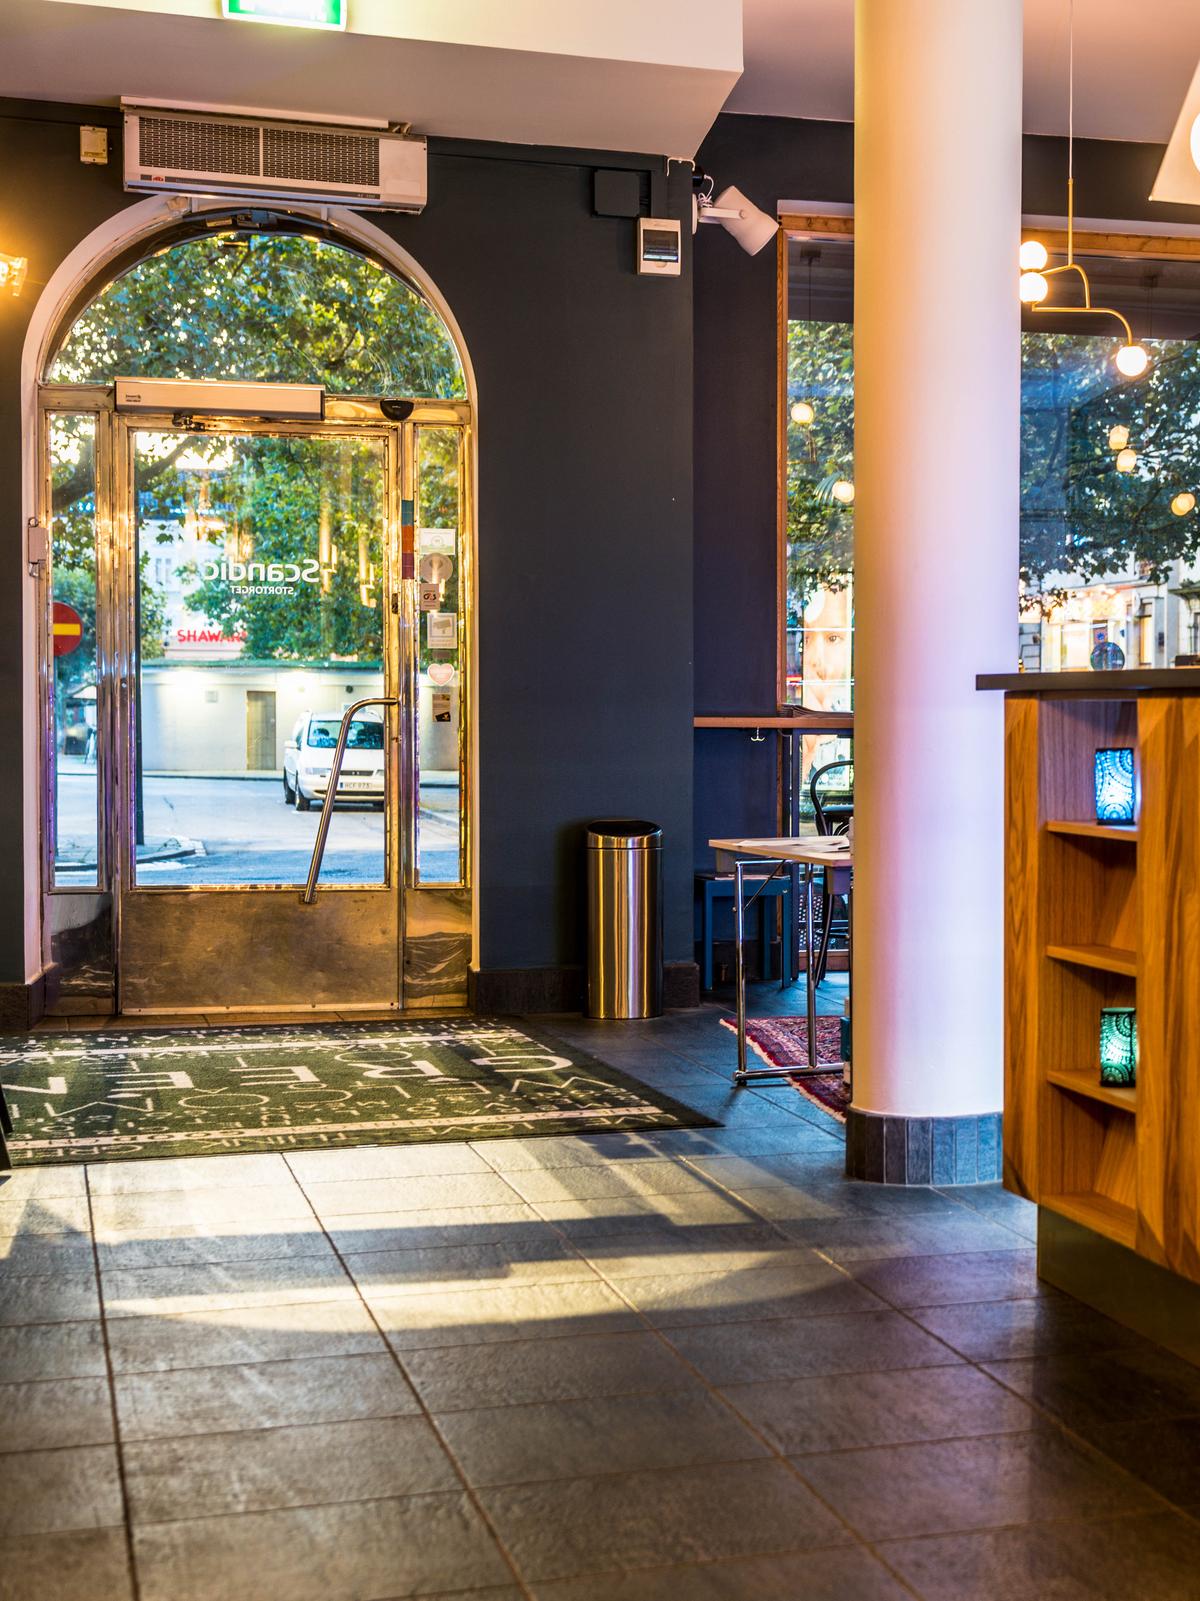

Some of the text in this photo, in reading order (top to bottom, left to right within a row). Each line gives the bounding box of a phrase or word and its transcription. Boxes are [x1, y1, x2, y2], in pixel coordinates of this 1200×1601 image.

[81, 1043, 558, 1074] HOTE
[7, 1075, 617, 1118] WELCOM
[192, 1080, 375, 1094] TO A
[39, 1094, 642, 1132] REVOLUTIO
[219, 1117, 332, 1128] THE
[7, 1125, 171, 1140] GREE
[8, 1113, 682, 1159] LIVE LOVE THINK GREE
[112, 1130, 246, 1142] GOOD
